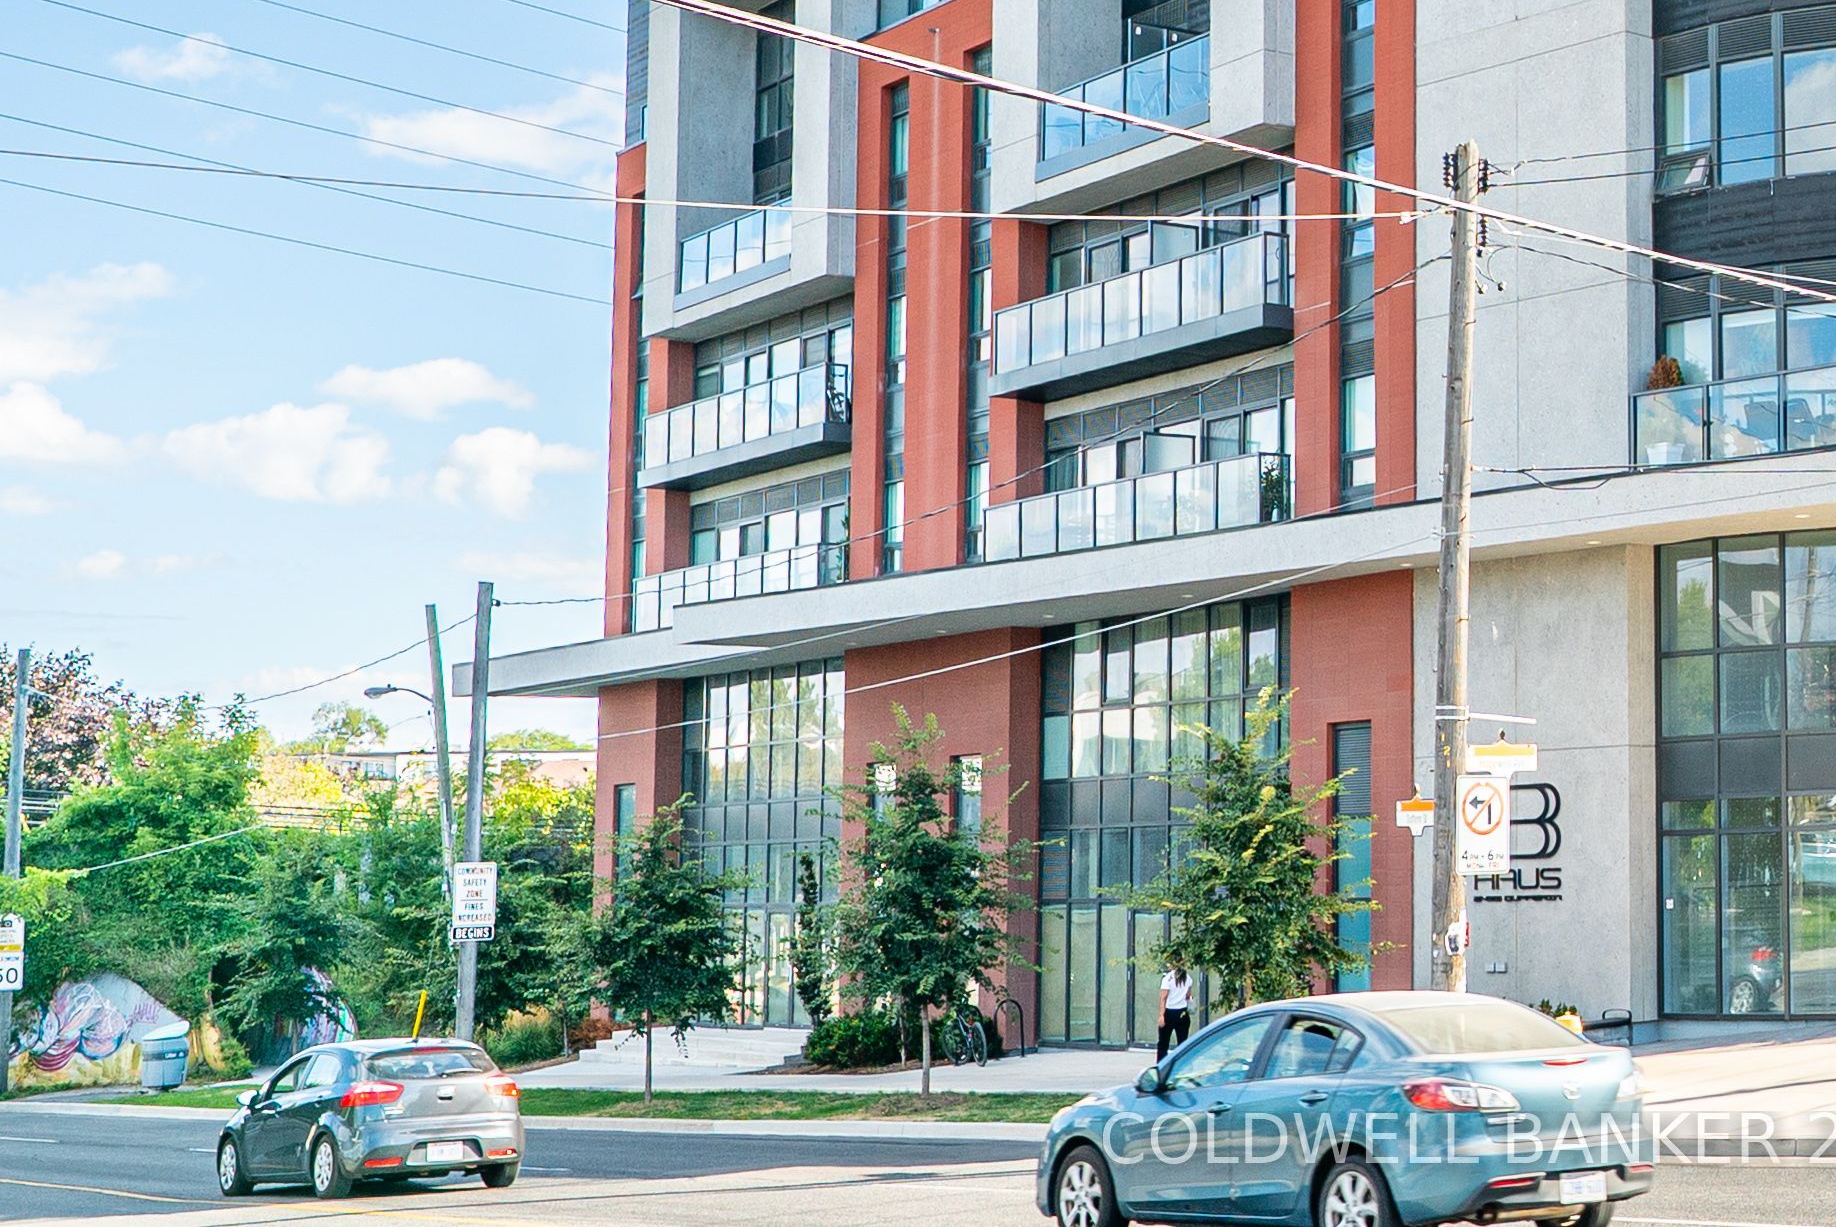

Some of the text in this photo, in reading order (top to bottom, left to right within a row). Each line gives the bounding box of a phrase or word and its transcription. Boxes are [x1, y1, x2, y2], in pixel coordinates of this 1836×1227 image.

[1462, 850, 1468, 860] 4
[1488, 850, 1494, 860] 6
[457, 867, 493, 876] COMMUNITY
[463, 878, 487, 887] SAFETY
[1474, 868, 1562, 890] HAUS
[466, 889, 483, 898] ZONE
[465, 903, 484, 911] FINES
[456, 913, 492, 922] INCREASED
[455, 927, 490, 939] BEGINS
